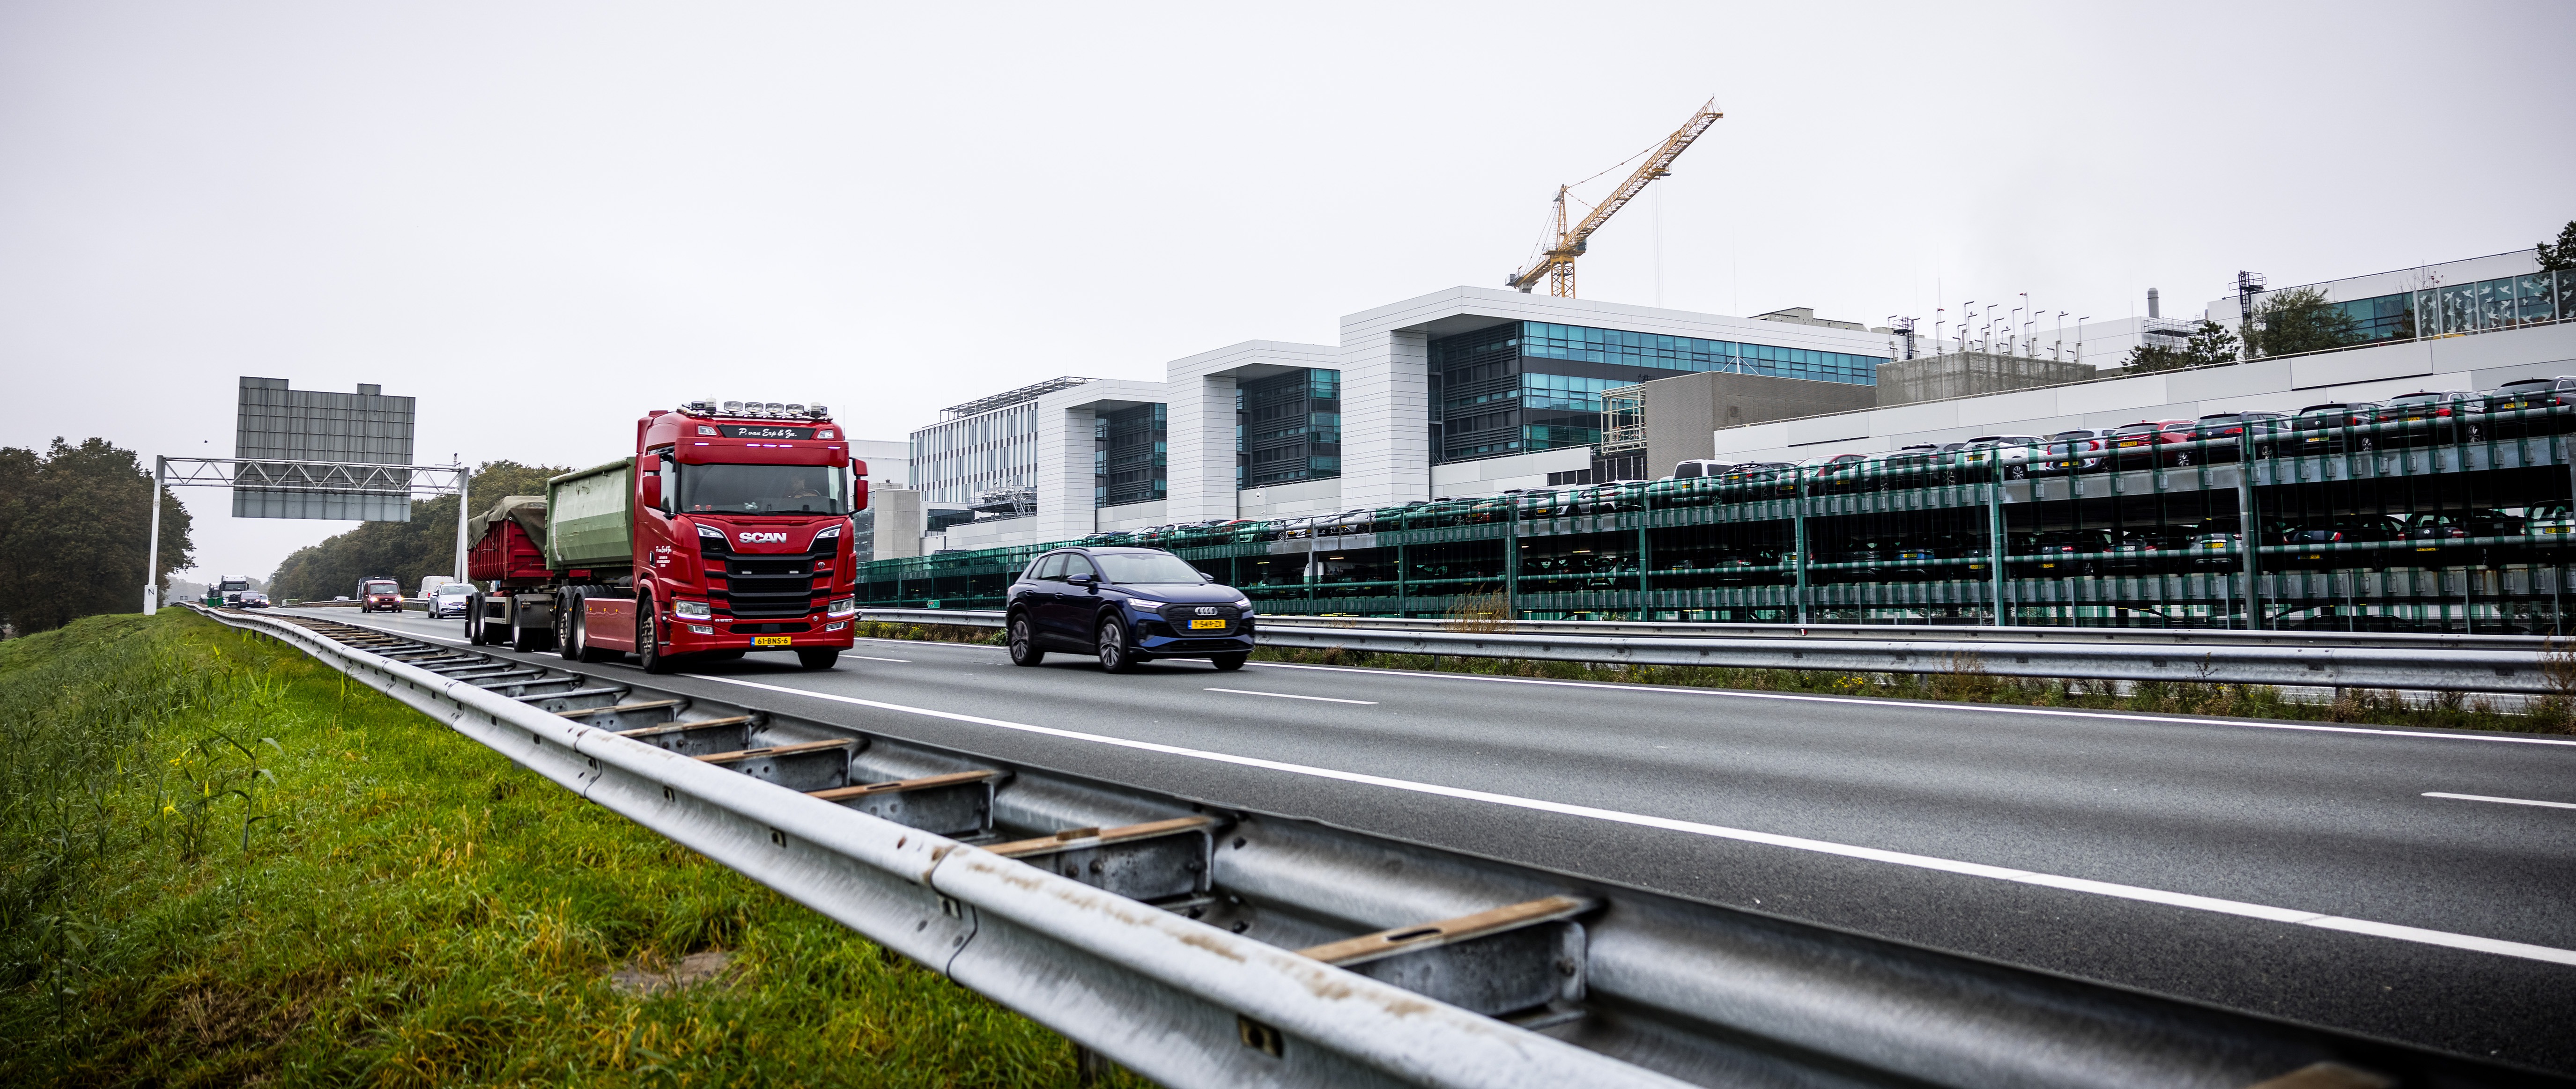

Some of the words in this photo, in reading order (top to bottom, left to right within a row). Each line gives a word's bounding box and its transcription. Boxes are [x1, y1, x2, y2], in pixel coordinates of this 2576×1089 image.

[762, 428, 777, 437] Erp
[785, 429, 797, 438] Zn.
[739, 532, 787, 543] SCAN
